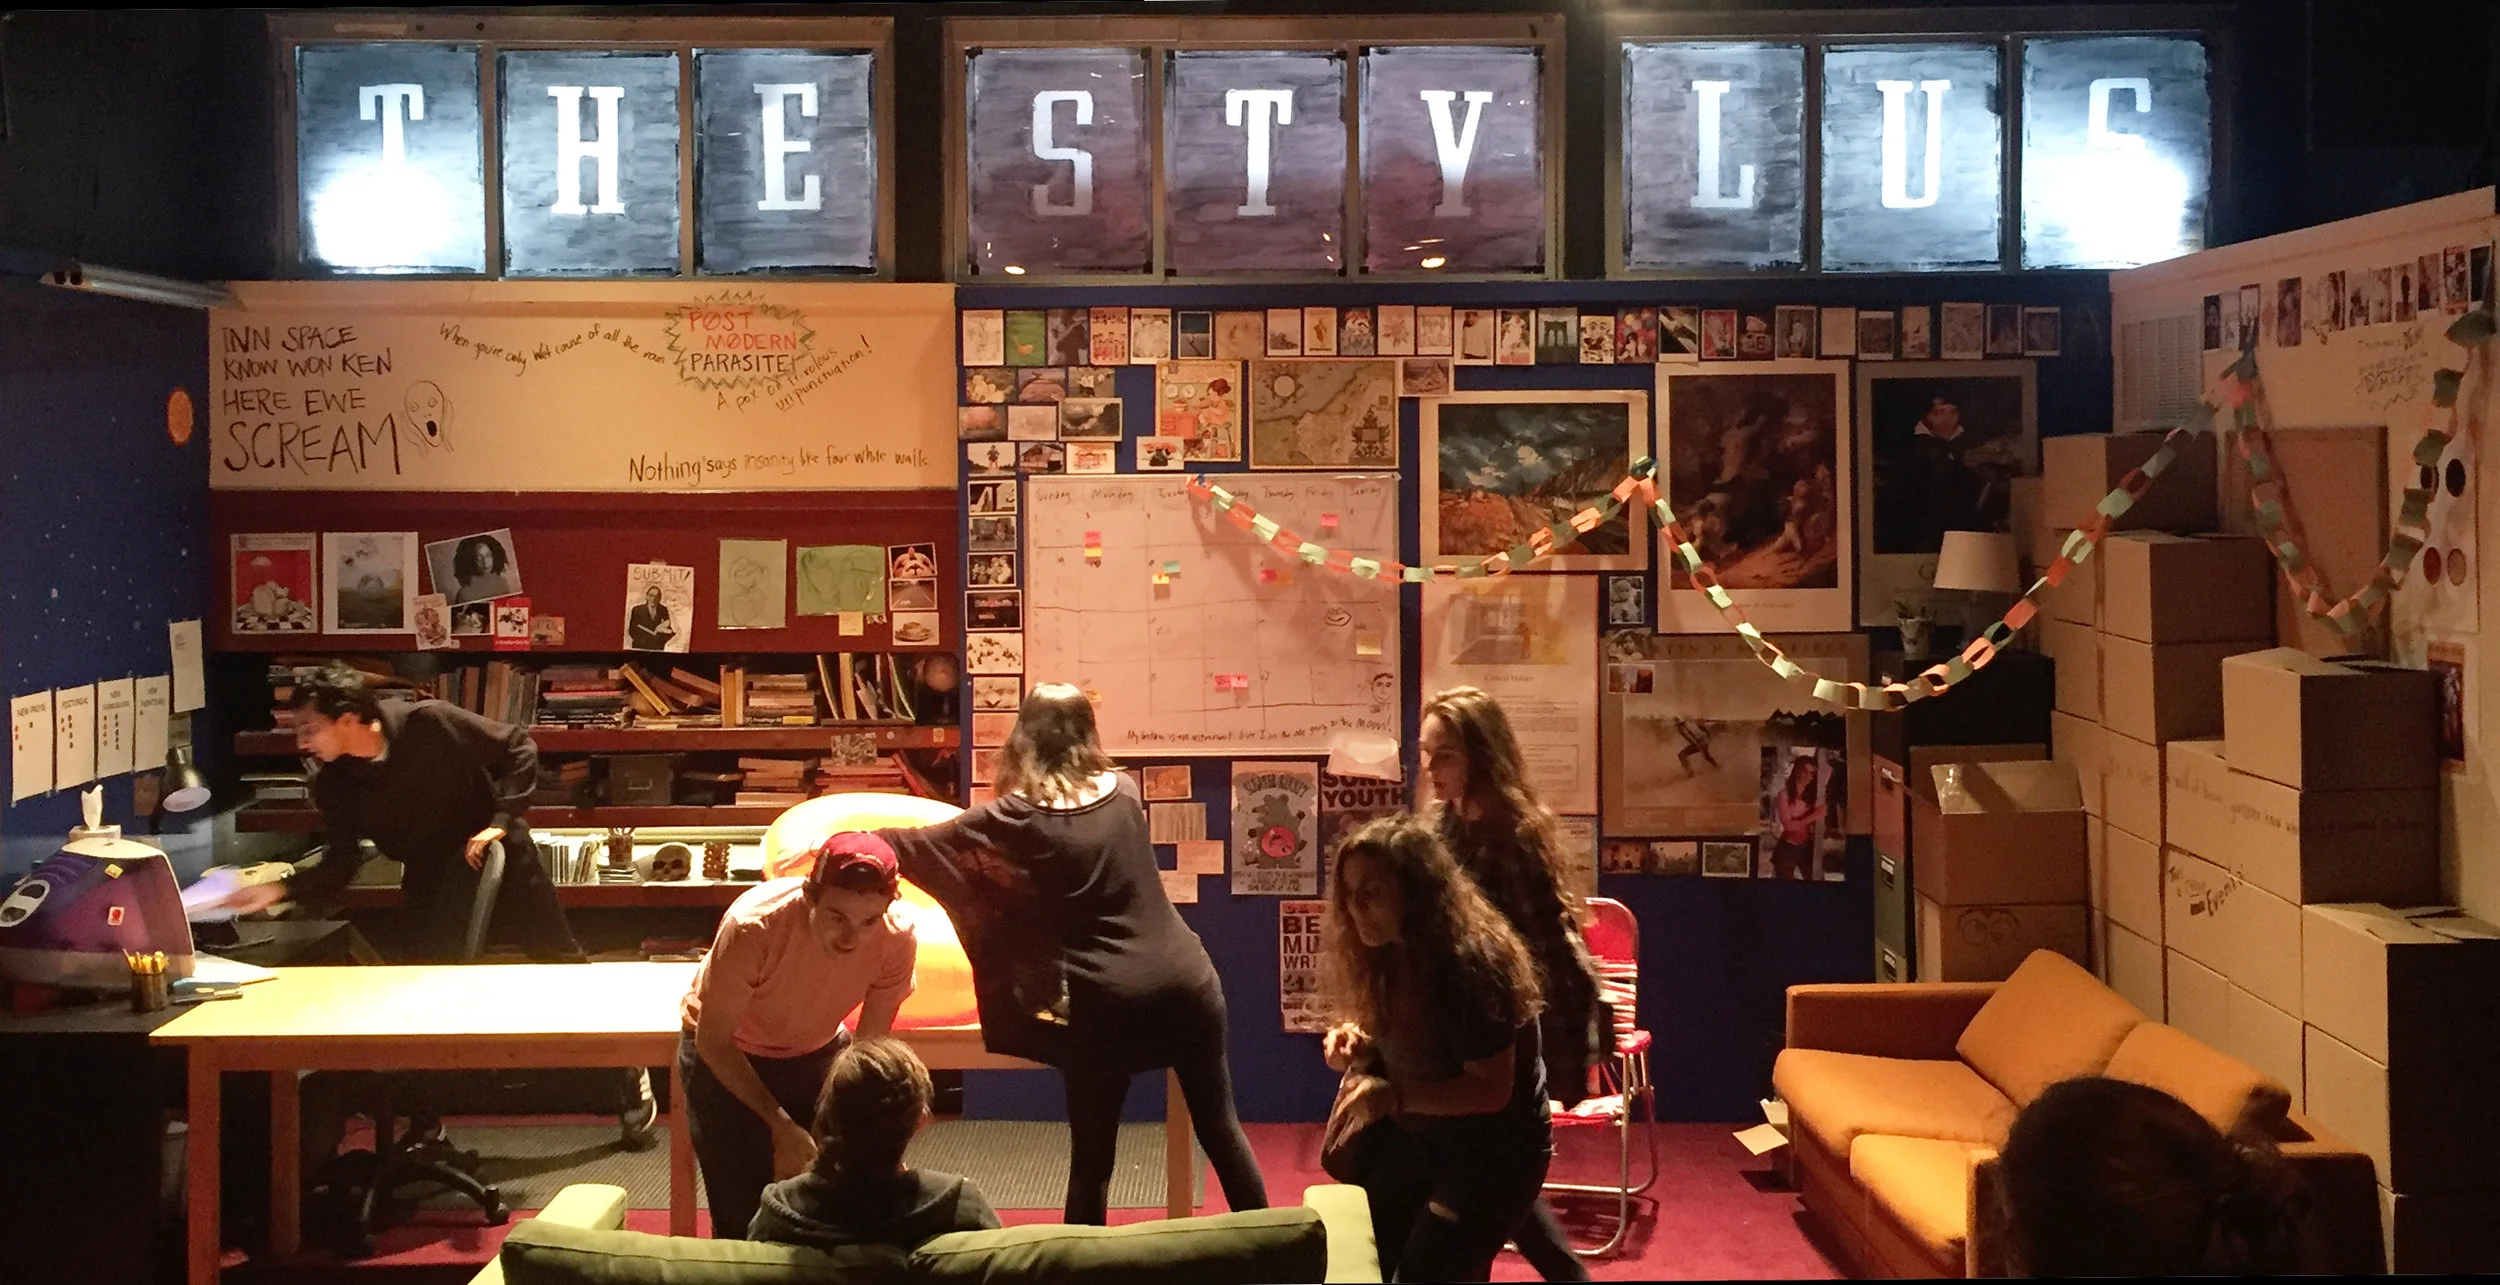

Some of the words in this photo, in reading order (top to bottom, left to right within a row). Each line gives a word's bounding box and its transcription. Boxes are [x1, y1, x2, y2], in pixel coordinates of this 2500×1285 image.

[359, 83, 822, 212] THE
[222, 327, 270, 352] INN
[281, 326, 357, 352] SPACE
[439, 322, 469, 348] When
[588, 322, 601, 340] of
[603, 328, 621, 342] all
[622, 335, 639, 353] the
[223, 358, 278, 381] KNOW
[287, 354, 333, 378] WON
[342, 347, 392, 377] KEN
[223, 388, 292, 416] HERE
[304, 388, 366, 417] EWE
[717, 391, 728, 410] A
[223, 412, 401, 475] SCREAM
[629, 451, 701, 487] Nothing
